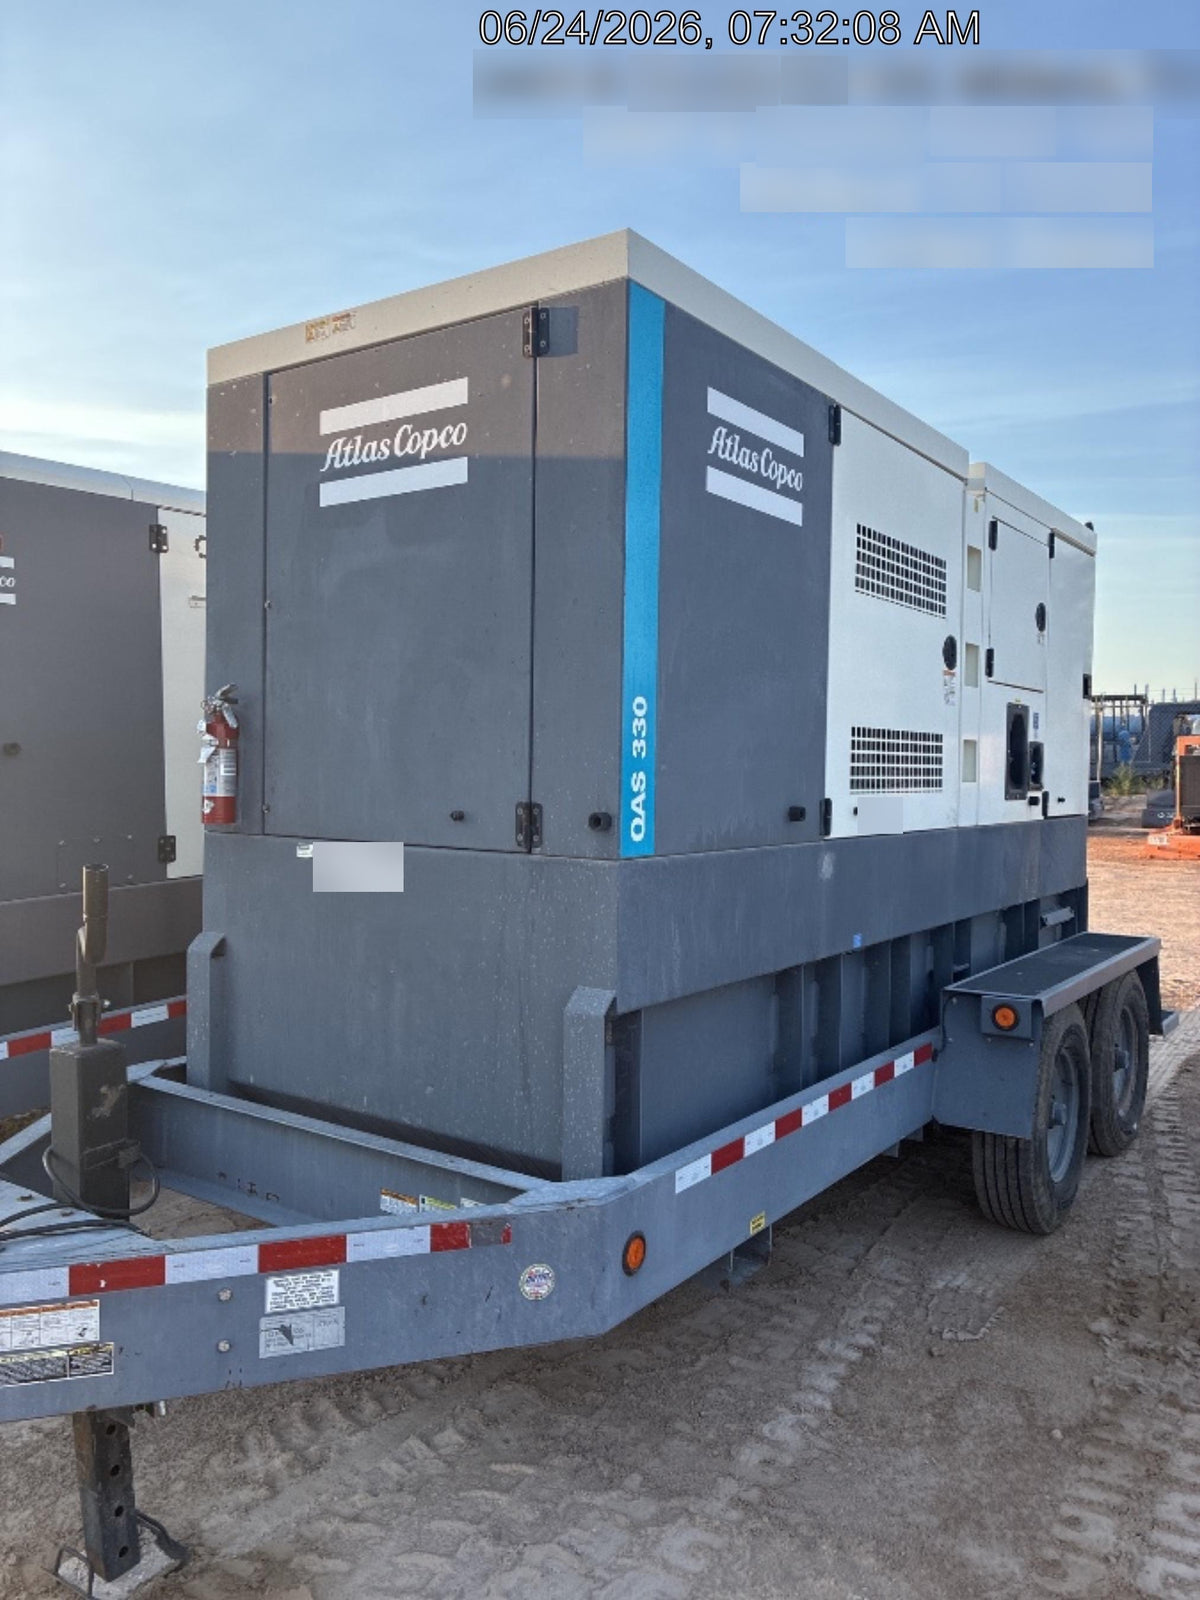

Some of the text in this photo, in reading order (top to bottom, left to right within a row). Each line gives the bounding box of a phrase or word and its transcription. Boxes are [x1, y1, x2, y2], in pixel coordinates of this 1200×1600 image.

[320, 422, 468, 472] Atlas Copco
[707, 426, 803, 492] Atlas Copco
[632, 696, 648, 760] 330
